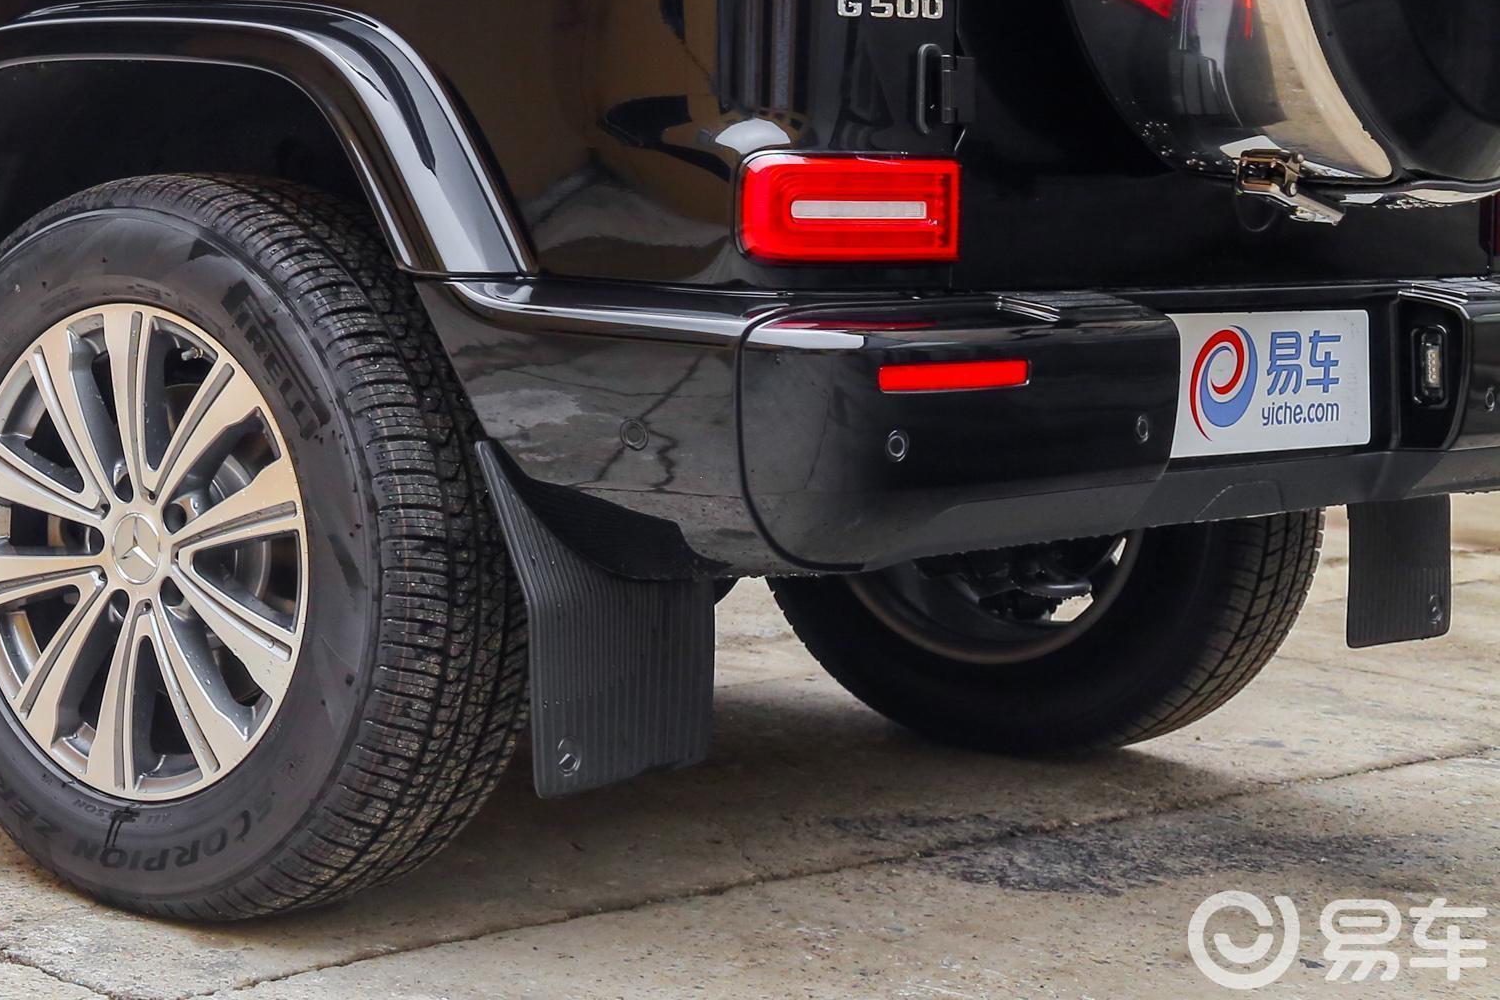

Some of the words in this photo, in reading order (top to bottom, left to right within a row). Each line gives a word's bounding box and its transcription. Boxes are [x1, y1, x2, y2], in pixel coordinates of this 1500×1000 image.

[220, 279, 332, 440] PIRELLI
[1266, 330, 1341, 396] 易车
[1261, 402, 1340, 426] yiche.com
[72, 793, 276, 872] SCORPION
